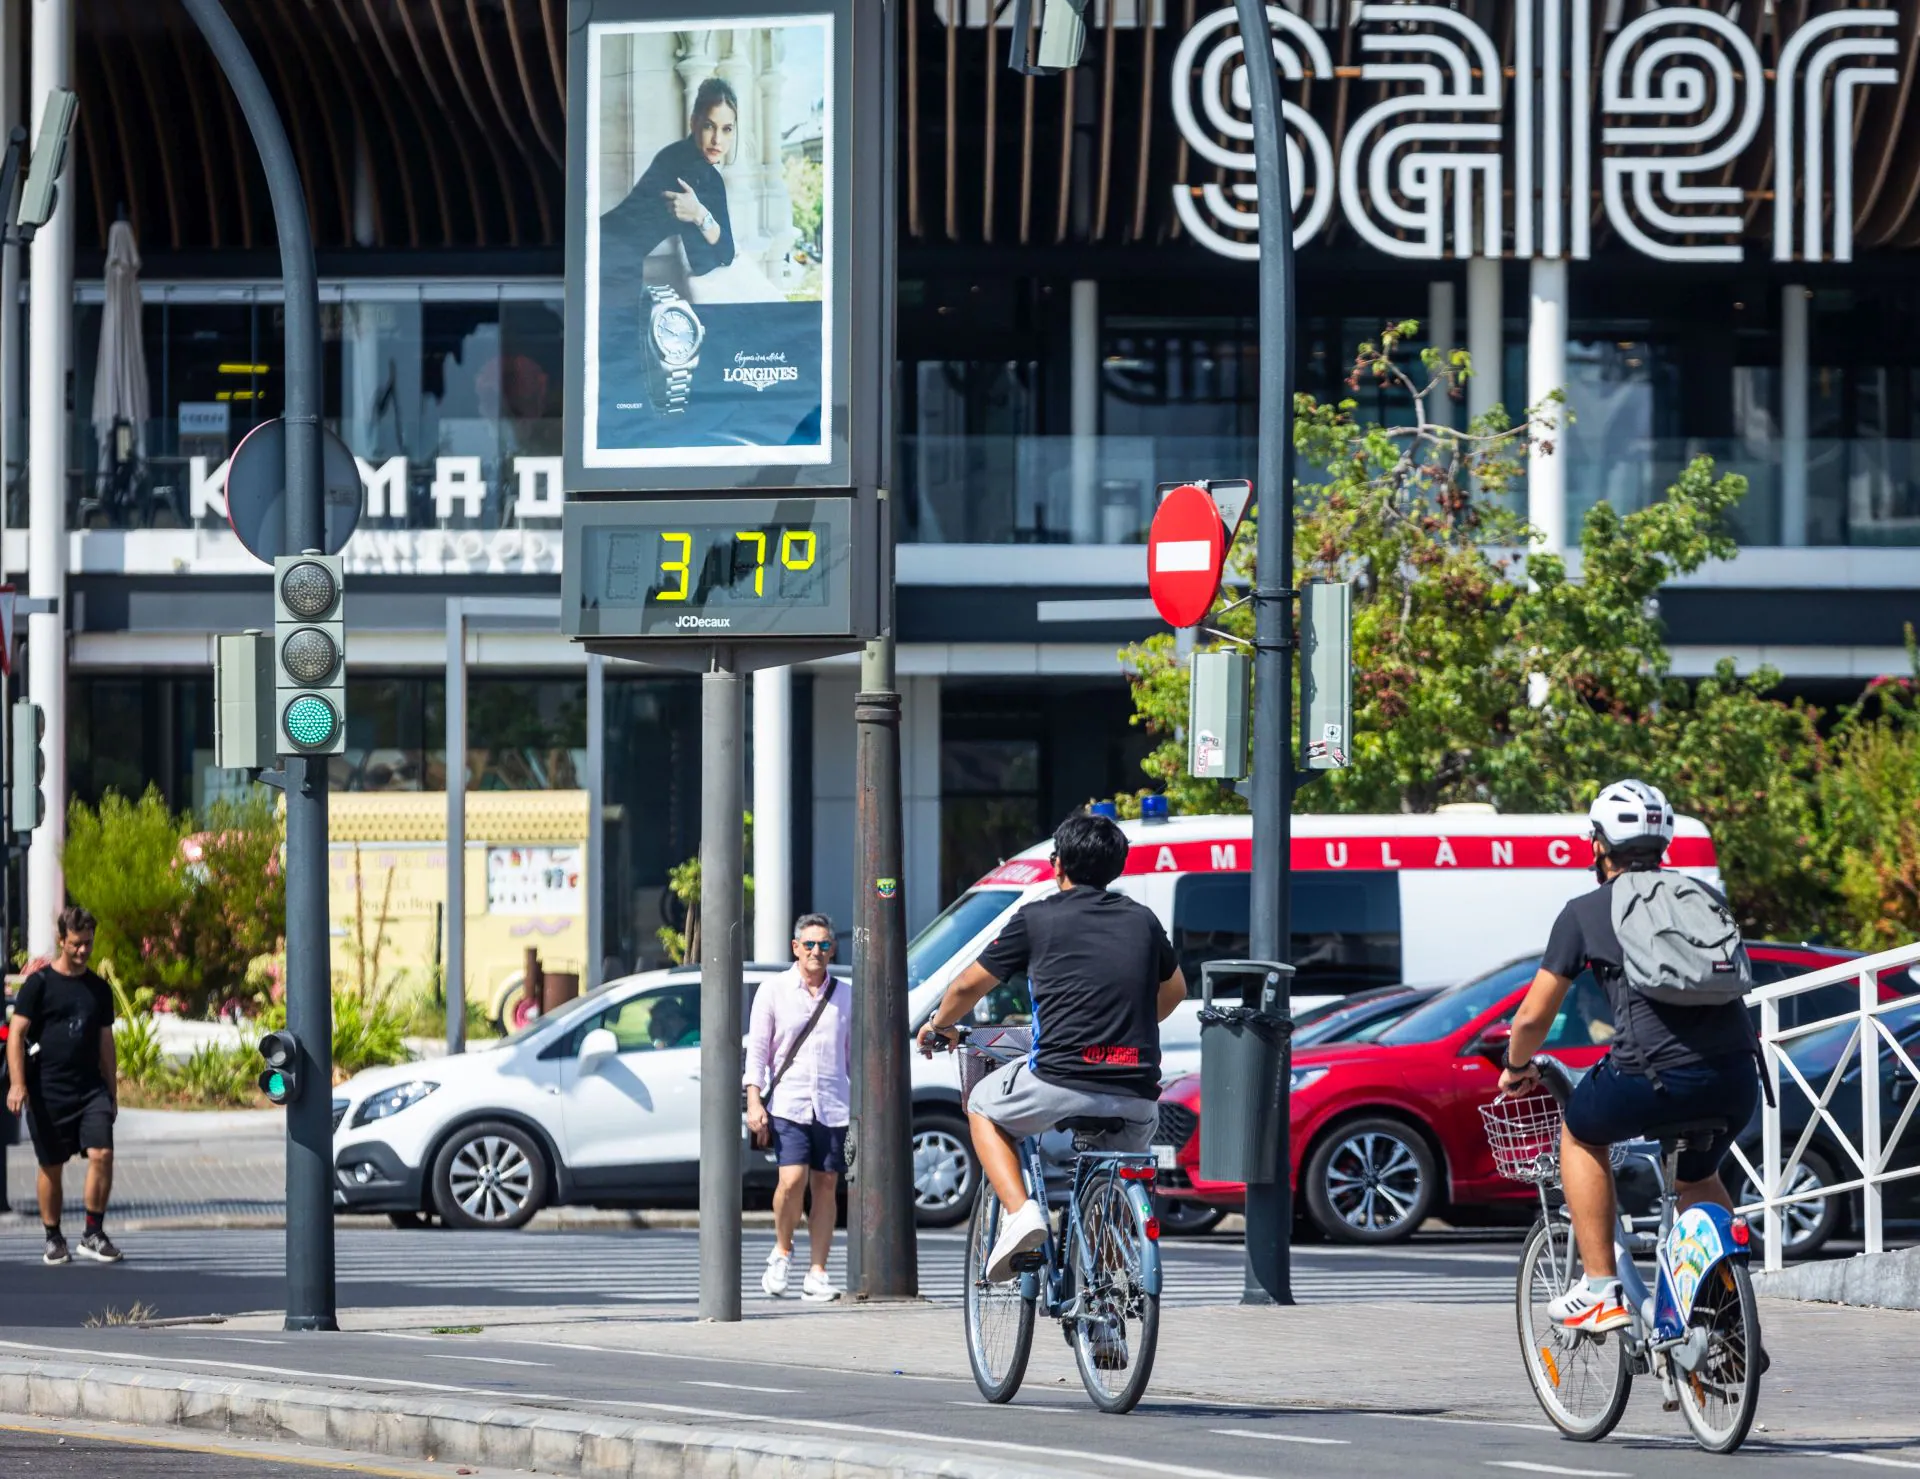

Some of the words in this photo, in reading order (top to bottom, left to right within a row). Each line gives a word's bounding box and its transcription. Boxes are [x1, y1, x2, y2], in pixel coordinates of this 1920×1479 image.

[1171, 0, 1899, 262] saler
[723, 366, 798, 382] LONGINES
[189, 456, 563, 518] KMAD
[675, 616, 731, 628] JCDecaux
